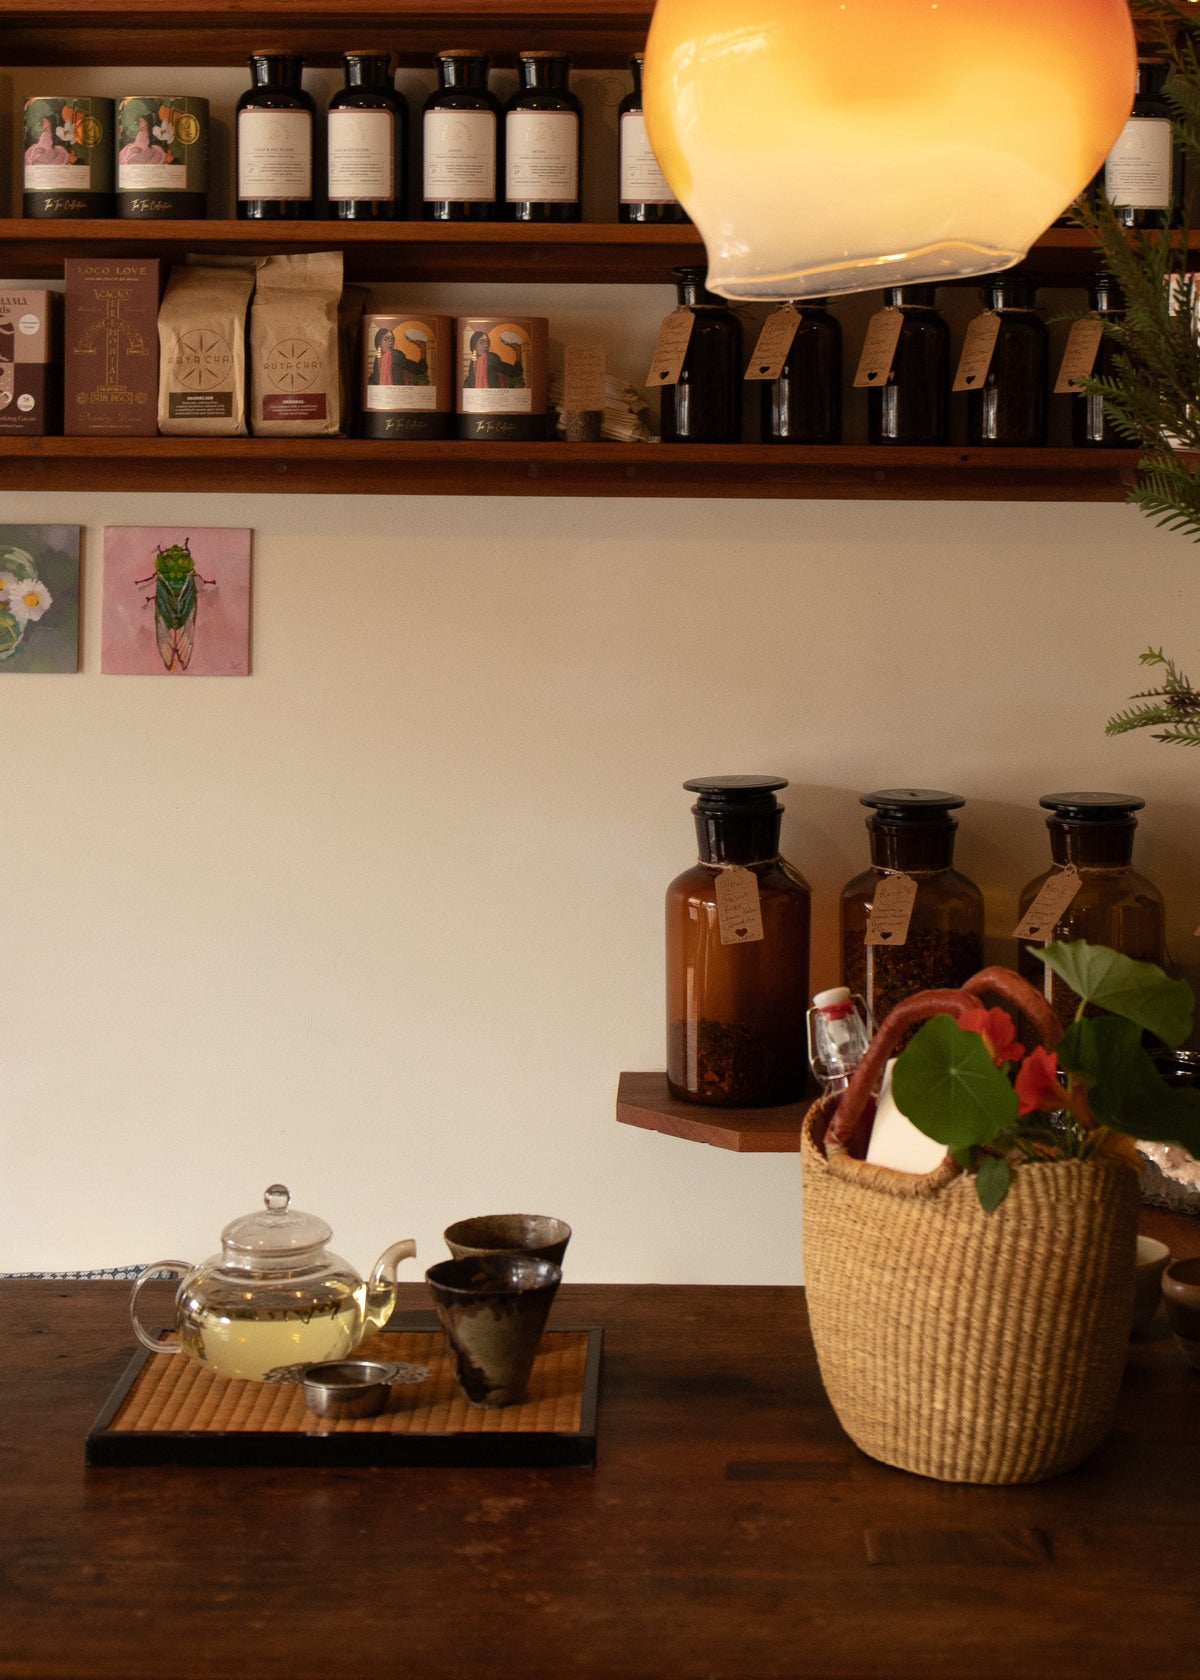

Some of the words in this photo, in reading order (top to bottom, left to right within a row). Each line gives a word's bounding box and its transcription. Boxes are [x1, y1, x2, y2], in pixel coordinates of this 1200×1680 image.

[78, 266, 111, 275] LOCO
[116, 267, 147, 275] LOVE
[204, 355, 234, 364] CHAI
[295, 361, 322, 369] CHAI
